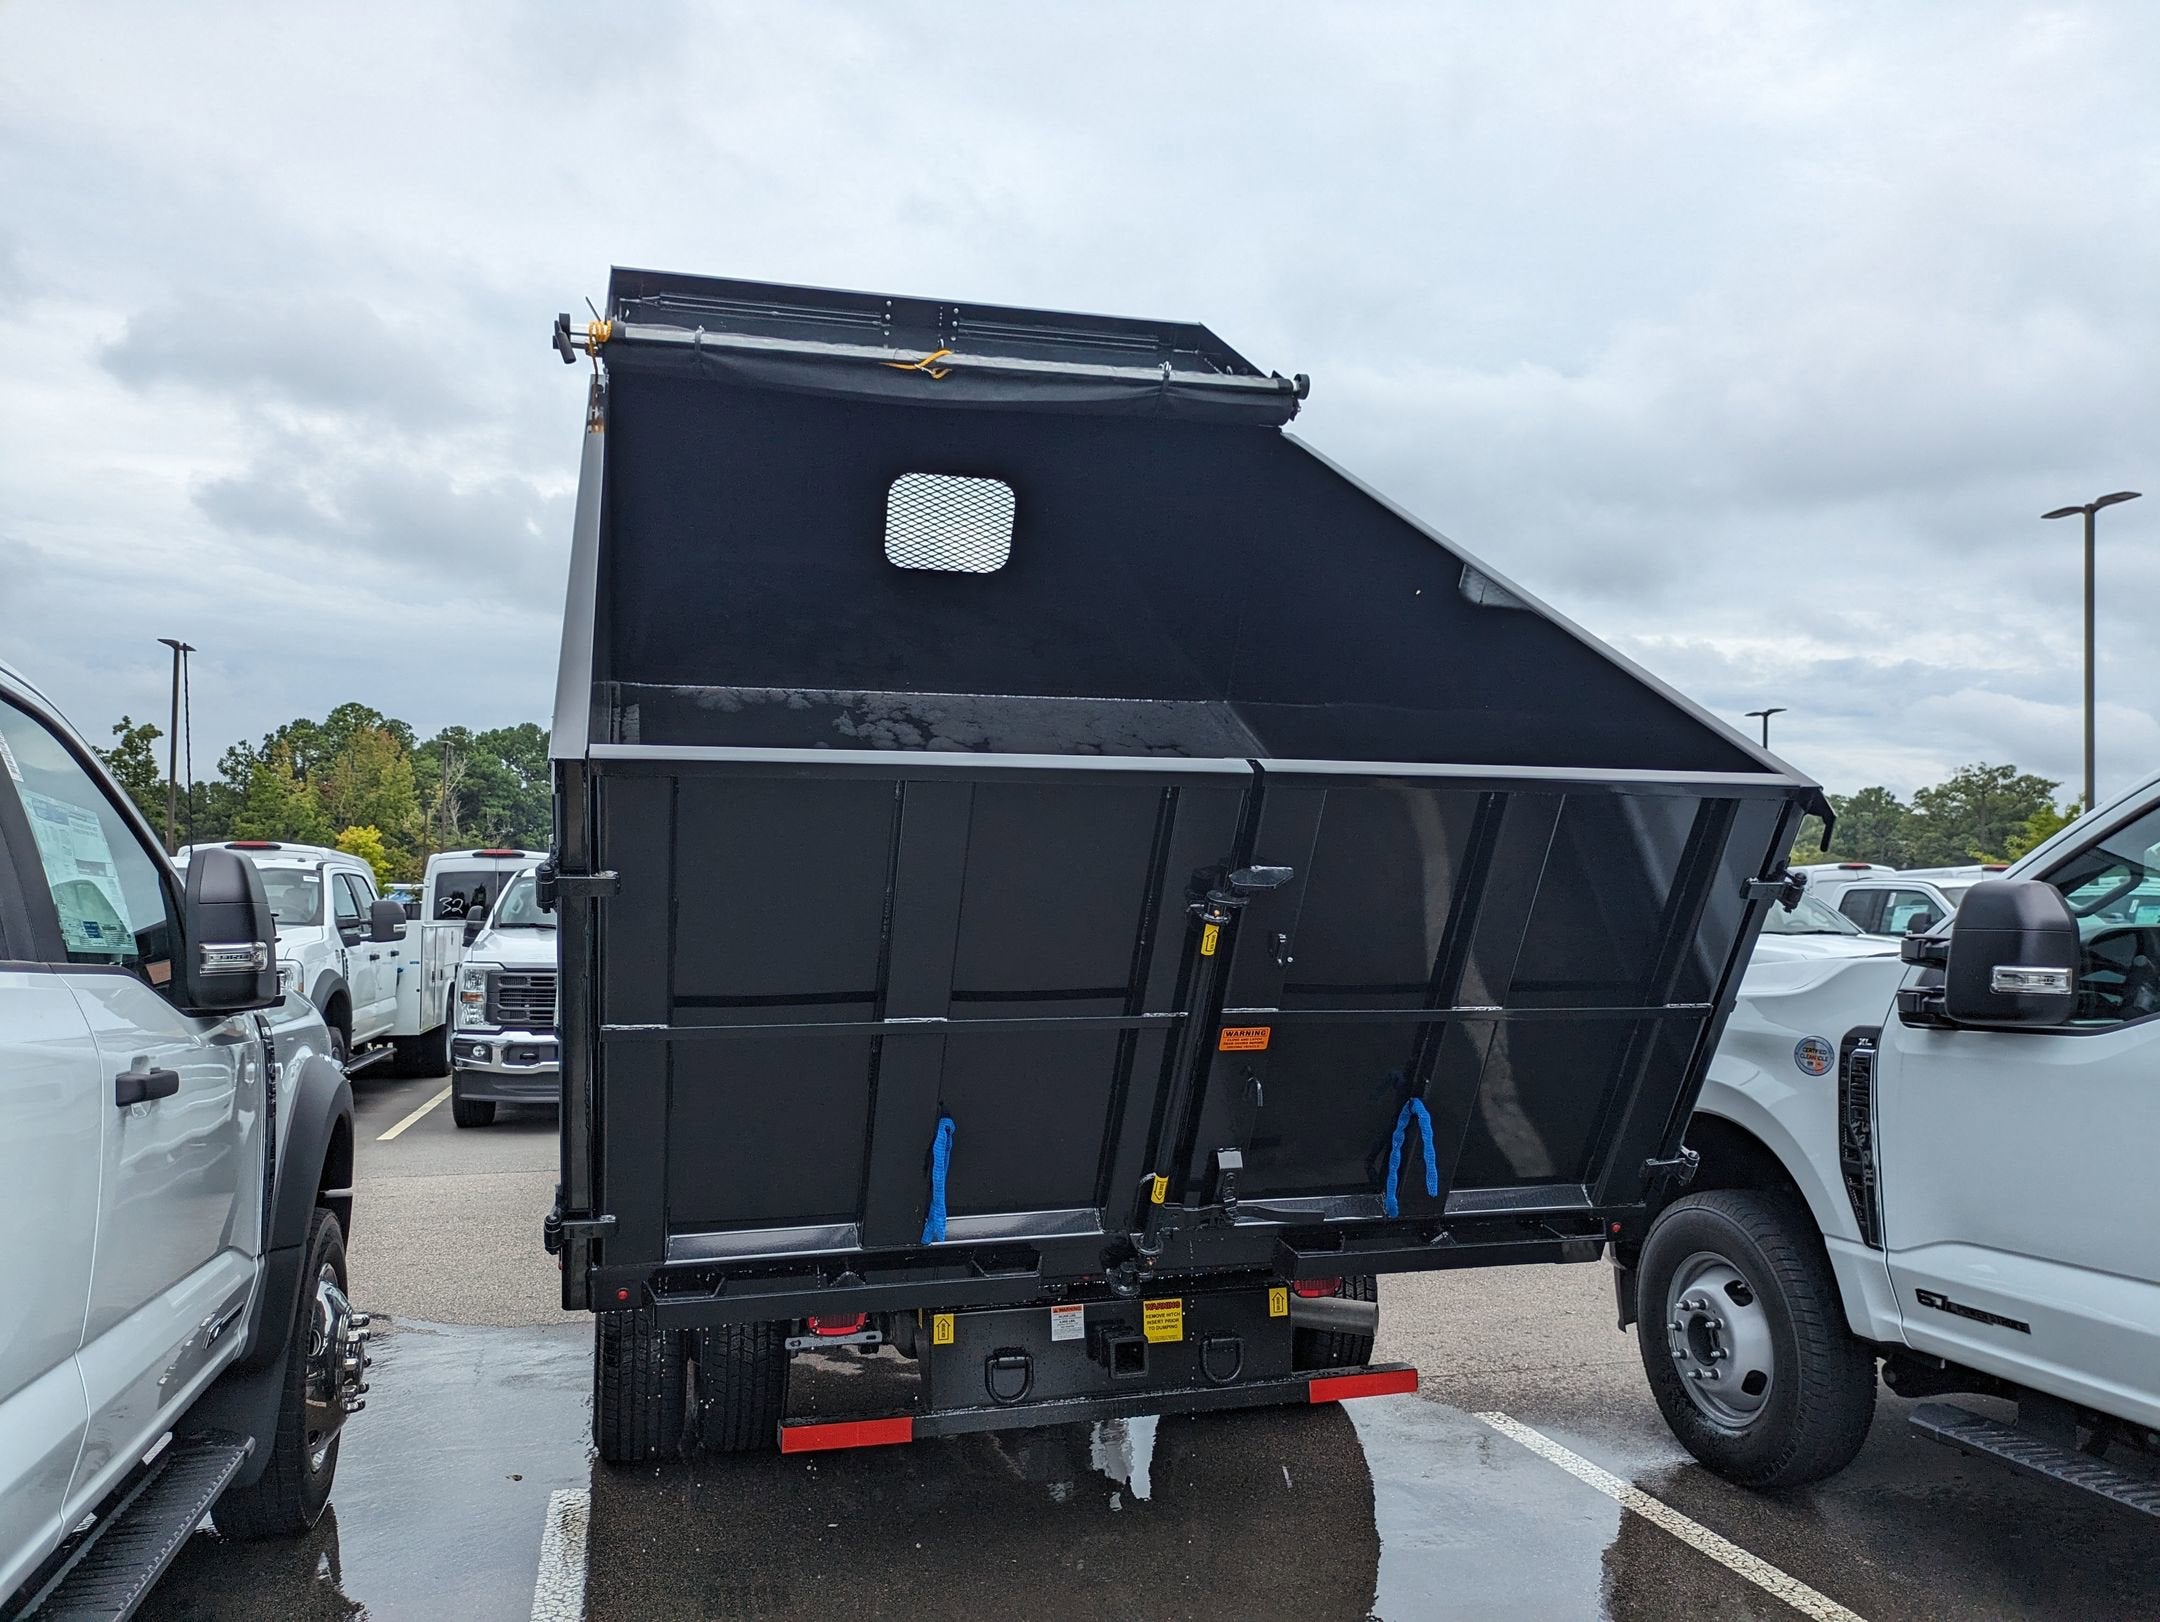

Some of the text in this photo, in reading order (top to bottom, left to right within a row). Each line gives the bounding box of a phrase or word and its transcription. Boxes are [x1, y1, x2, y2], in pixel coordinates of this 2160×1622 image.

[439, 896, 464, 914] 32
[1857, 1037, 1873, 1046] XL
[1145, 1301, 1180, 1310] WARNING
